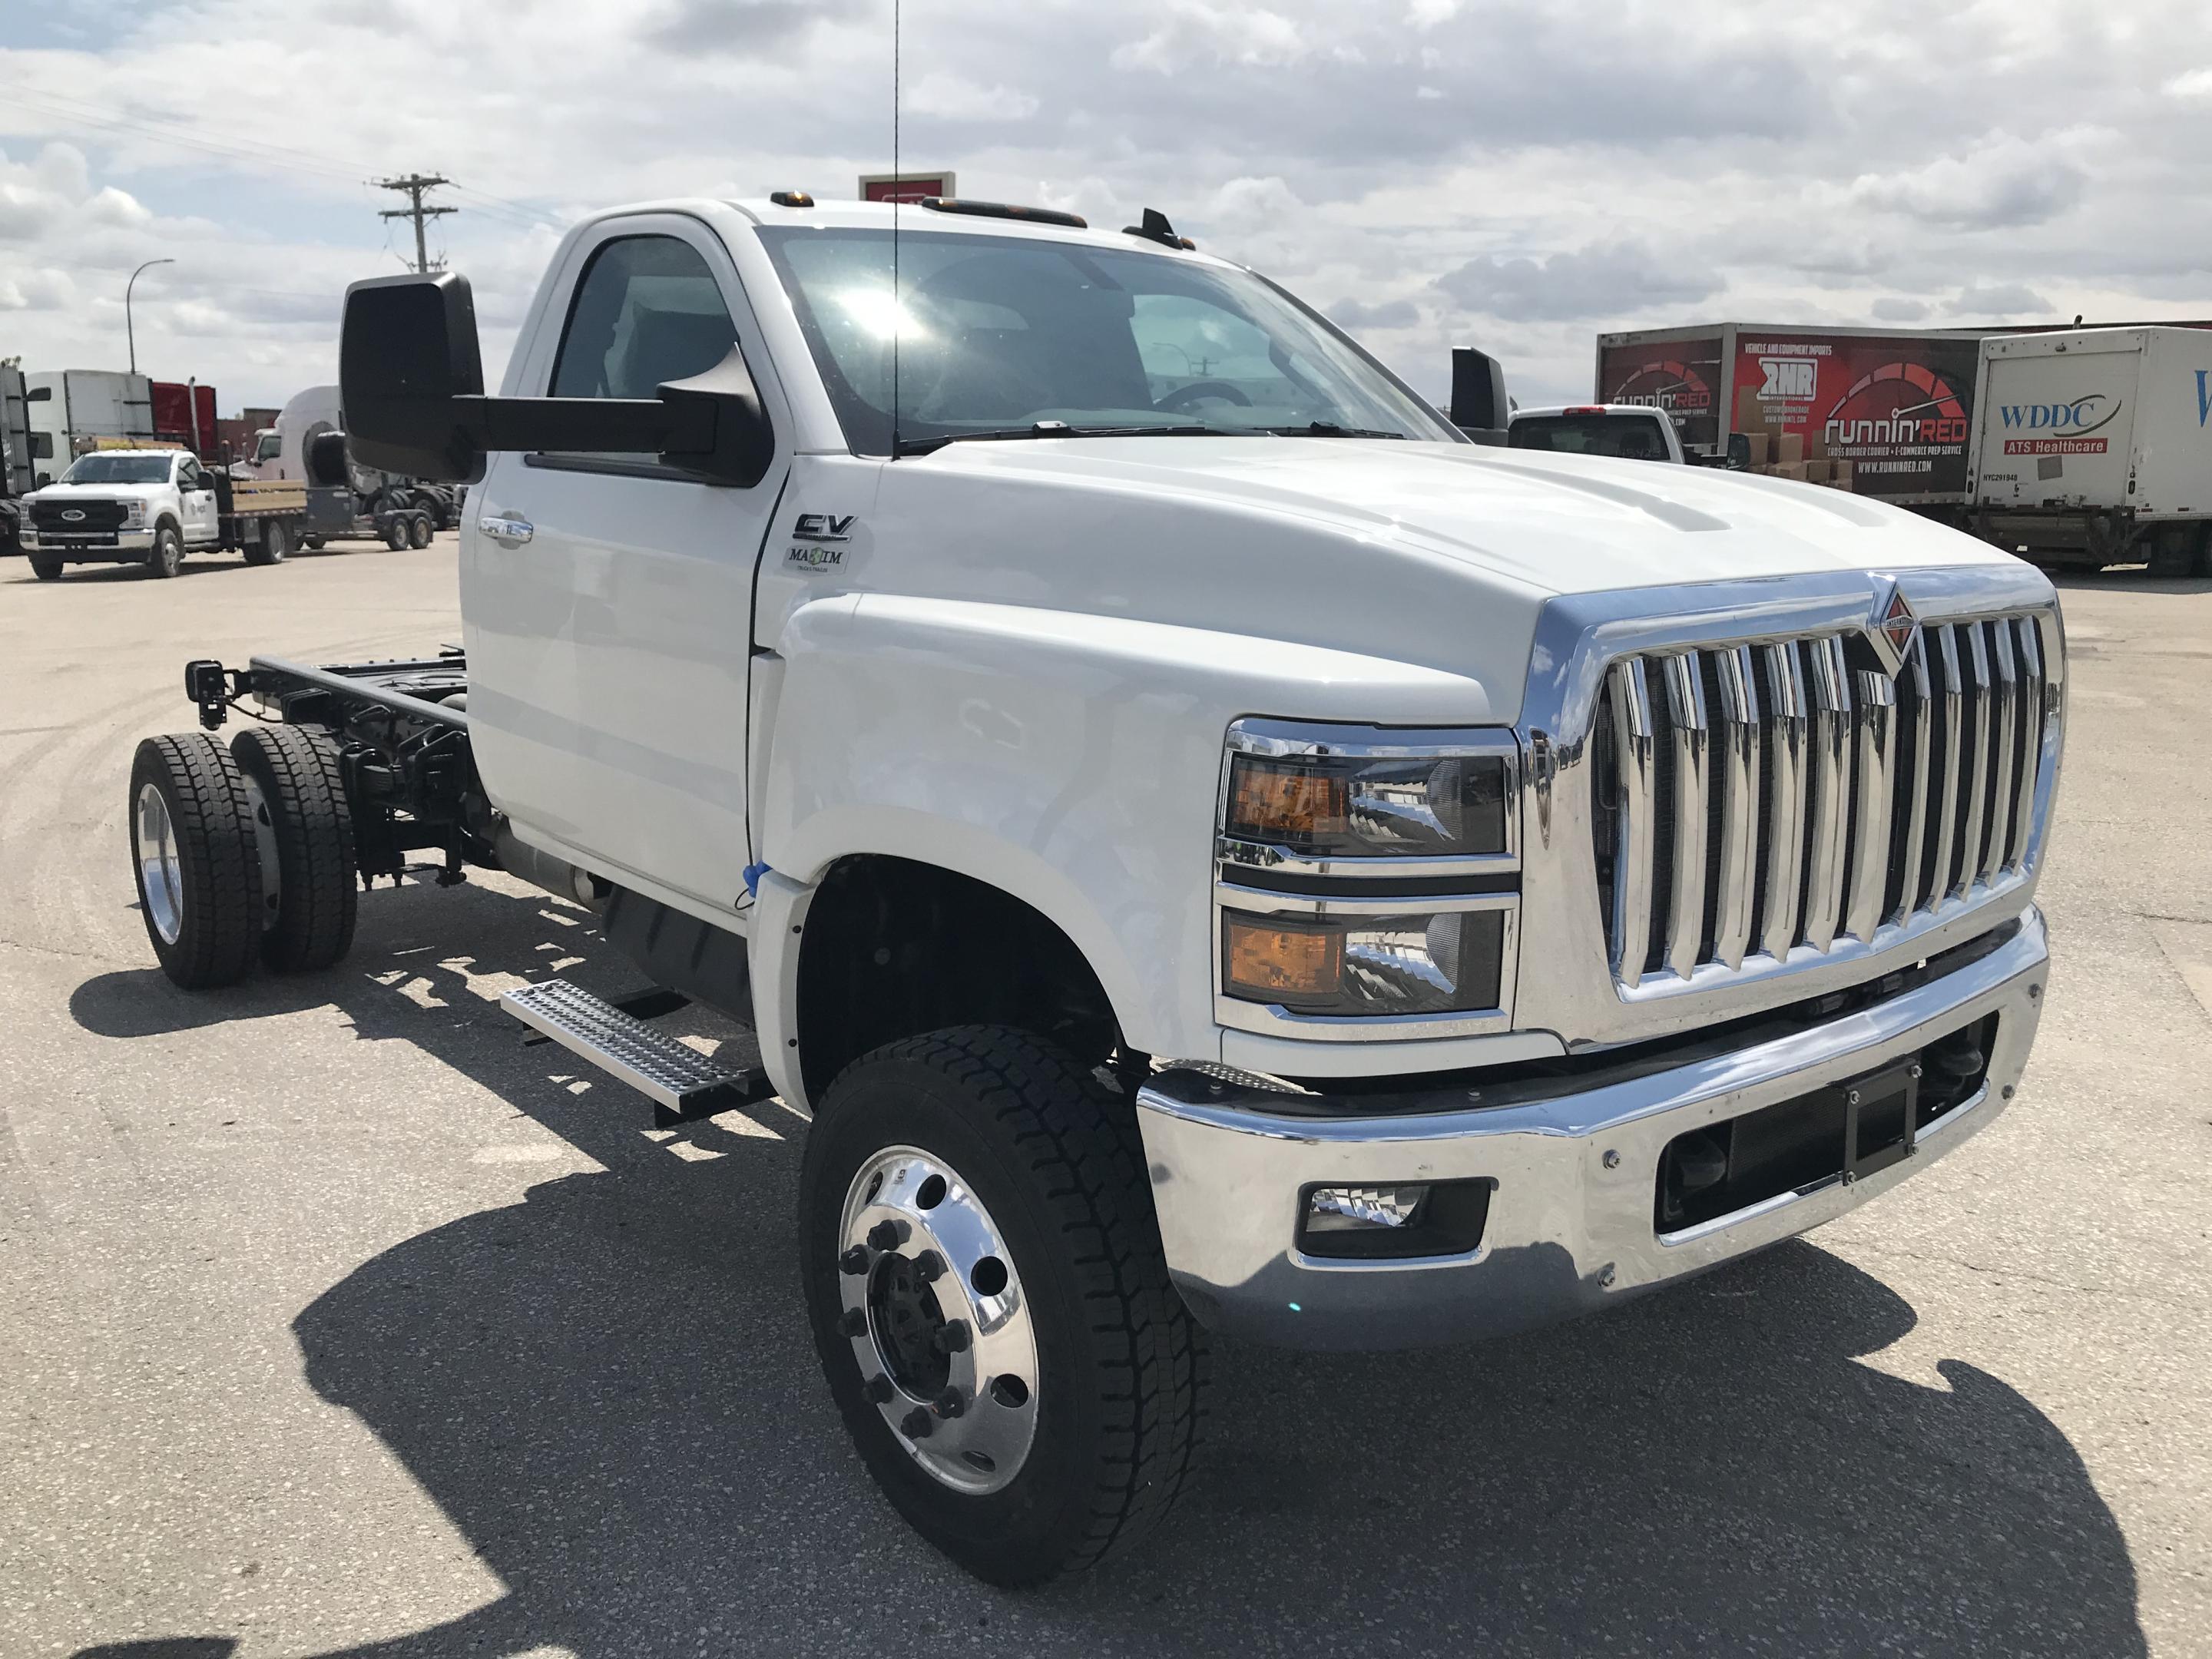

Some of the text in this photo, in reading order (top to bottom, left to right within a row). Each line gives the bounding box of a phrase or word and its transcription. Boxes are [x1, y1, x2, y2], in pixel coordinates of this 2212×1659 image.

[1809, 345, 1832, 356] IMPORTS
[2000, 403, 2094, 429] WDDC
[1867, 446, 1889, 456] COURIER
[1928, 445, 1941, 455] PREP
[1942, 445, 1962, 455] SERVICE
[2008, 441, 2104, 453] ATS Healthcare
